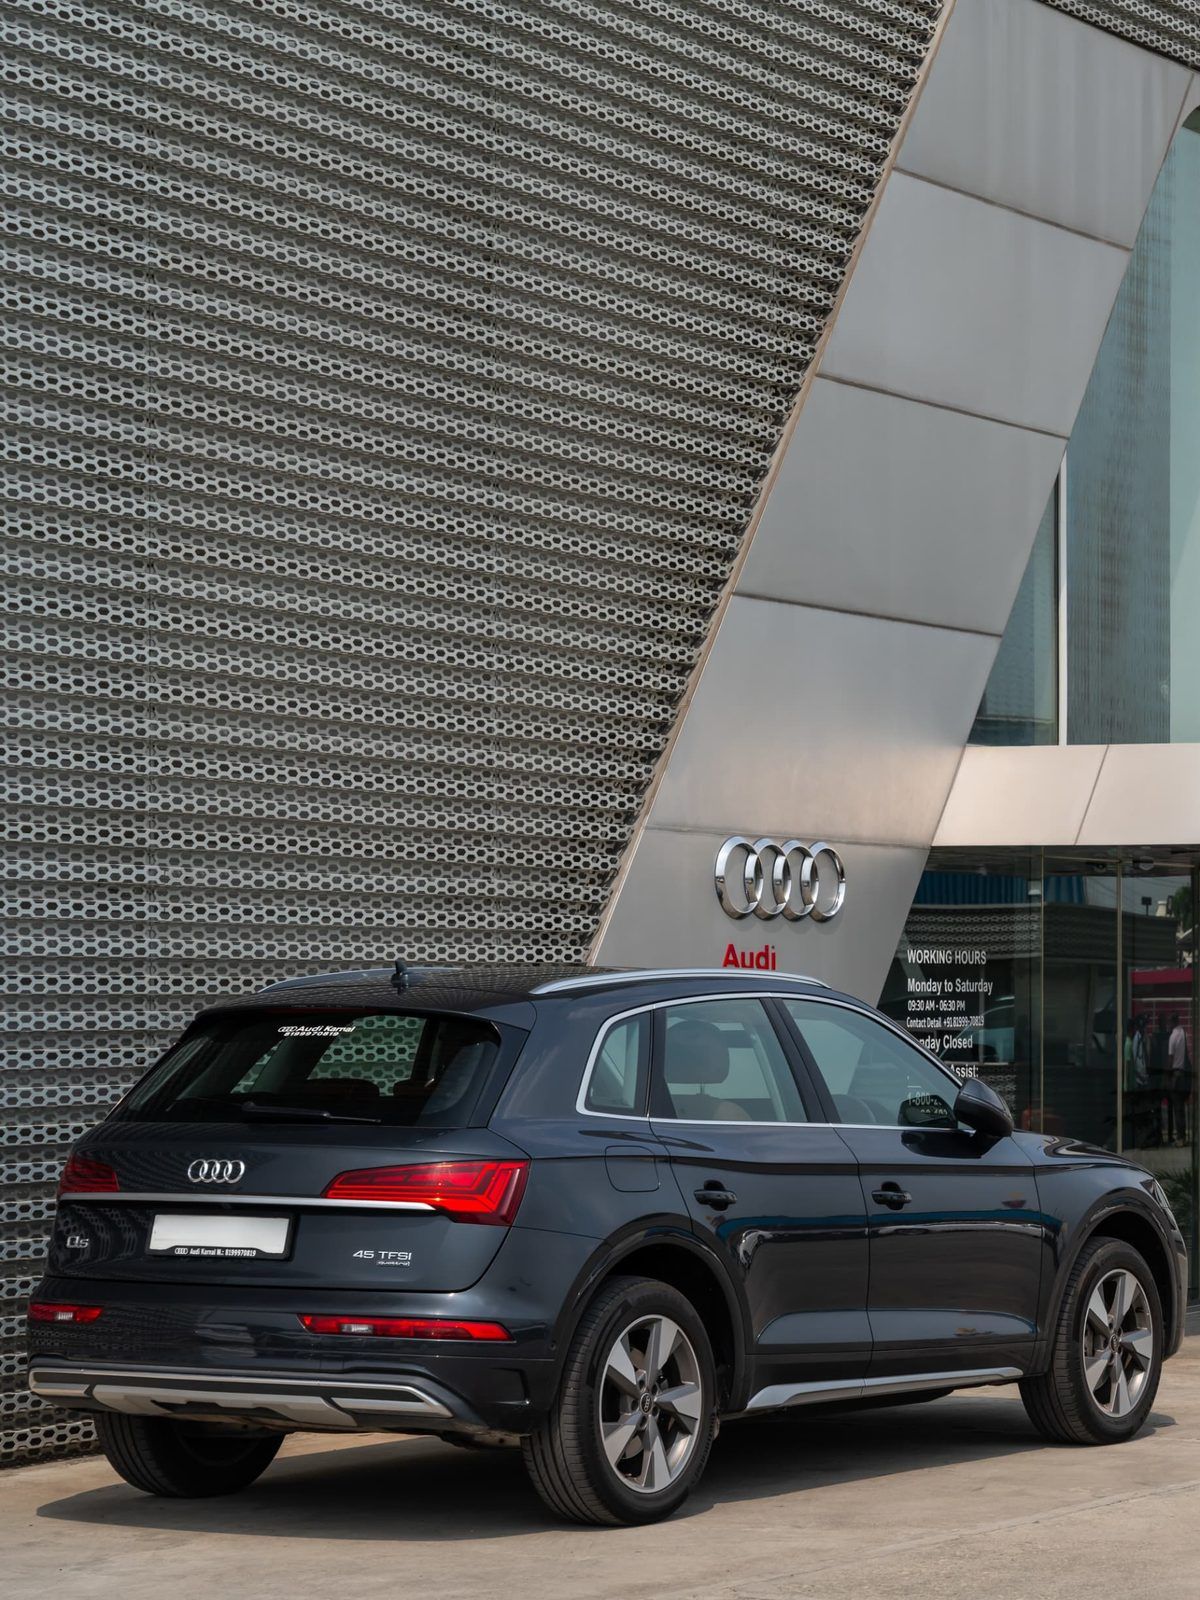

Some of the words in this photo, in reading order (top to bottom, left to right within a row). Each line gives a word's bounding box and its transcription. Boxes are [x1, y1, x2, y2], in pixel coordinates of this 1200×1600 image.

[722, 943, 776, 971] Audi
[907, 949, 952, 964] WORKING
[955, 950, 987, 965] HOURS
[907, 978, 942, 995] Monday
[944, 978, 953, 993] to
[955, 978, 993, 995] Saturday
[907, 1000, 924, 1011] 09:30
[925, 1000, 935, 1011] AM
[939, 1000, 955, 1011] 06:30
[956, 1000, 965, 1011] PM
[906, 1016, 926, 1028] Contact
[927, 1016, 941, 1028] Detail
[919, 1035, 941, 1052] nday
[943, 1034, 973, 1049] Closed
[189, 1247, 201, 1255] Audi
[201, 1248, 216, 1256] Karnal
[225, 1249, 256, 1257] 8199970819
[352, 1249, 375, 1259] 45
[378, 1250, 412, 1261] TFSI
